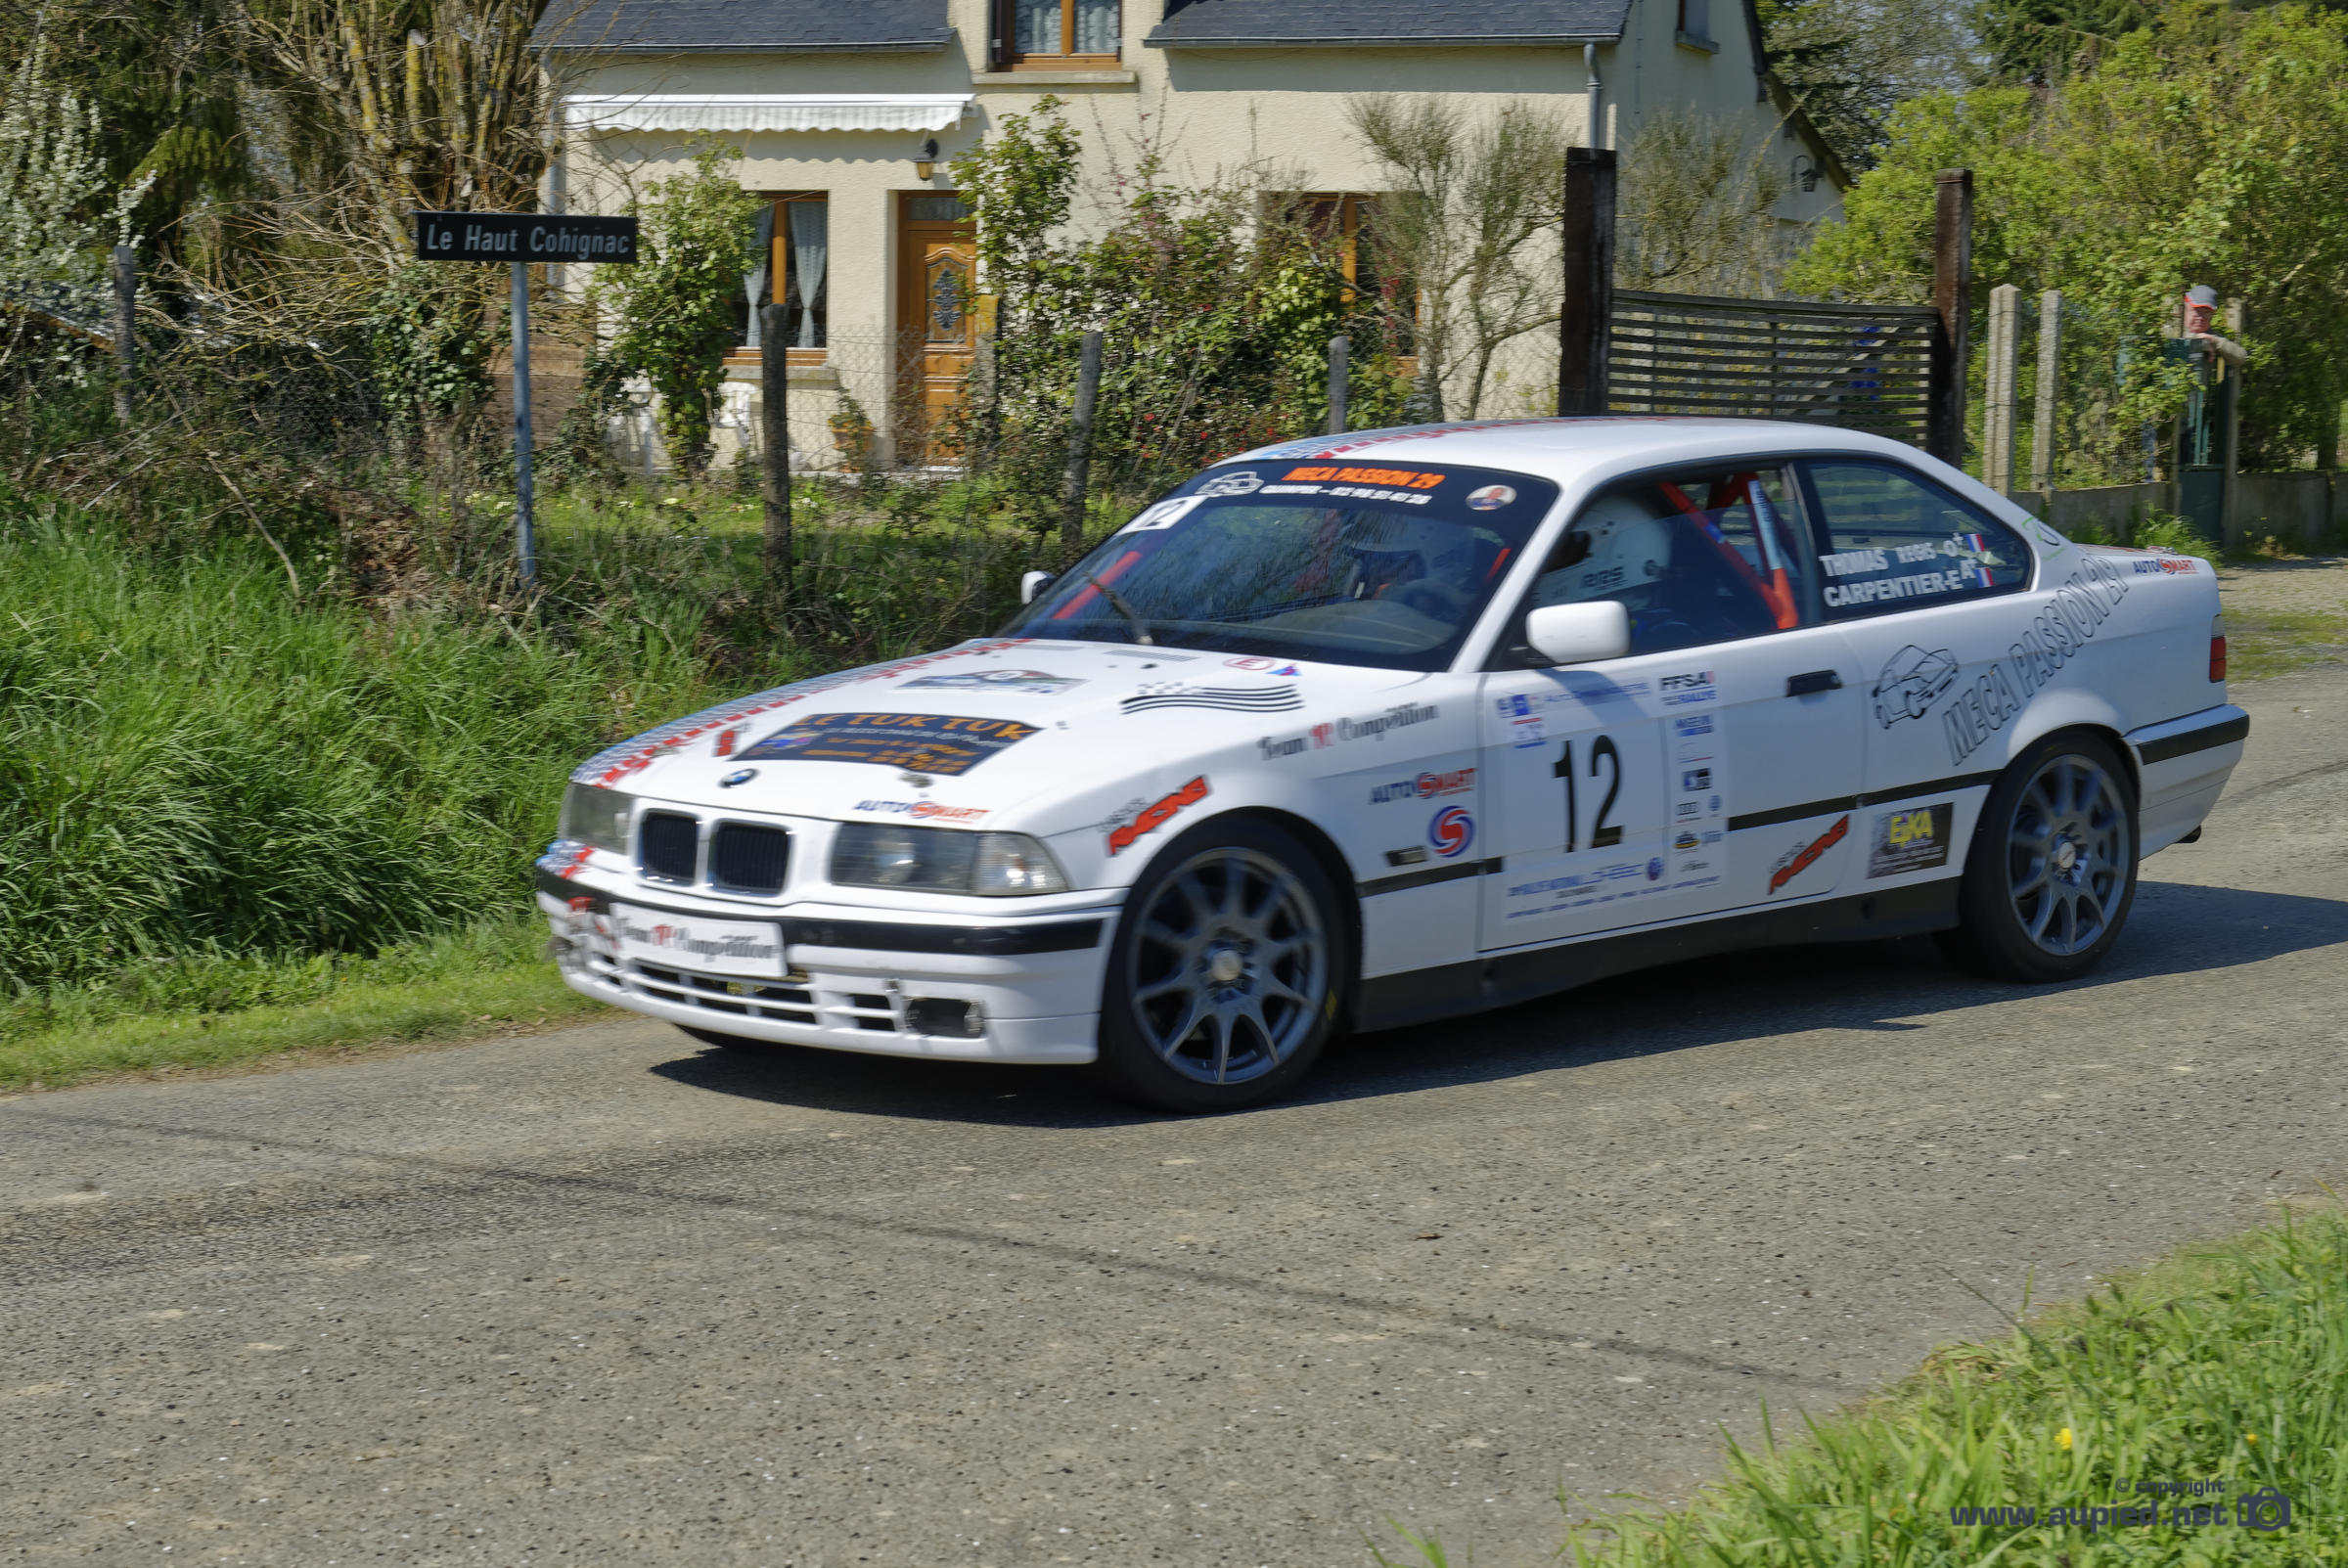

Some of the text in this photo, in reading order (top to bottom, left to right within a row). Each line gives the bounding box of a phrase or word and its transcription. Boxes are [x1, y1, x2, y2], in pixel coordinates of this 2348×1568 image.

[426, 224, 631, 261] Le Haut Cohignac
[1819, 547, 1888, 577] THOMAS
[847, 714, 940, 728] TUK
[941, 717, 1035, 740] TUK
[1552, 735, 1625, 853] 12
